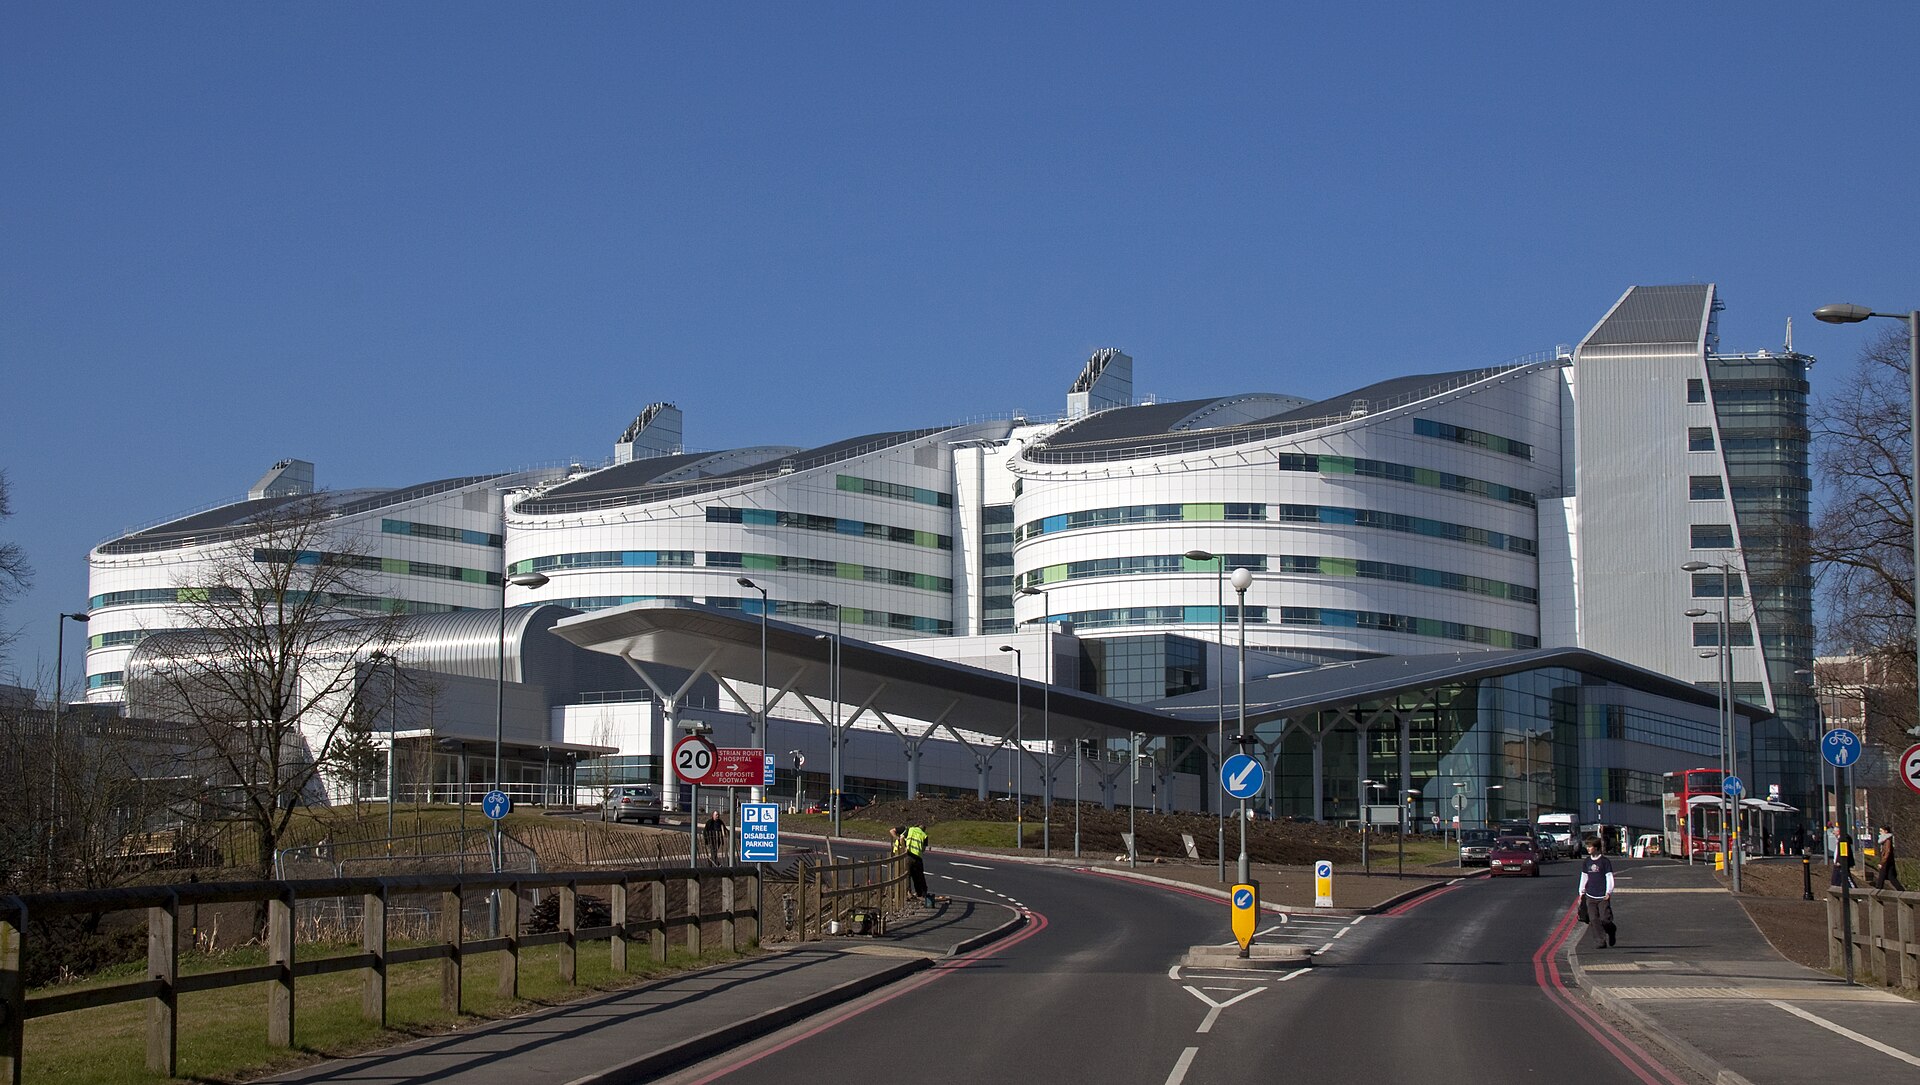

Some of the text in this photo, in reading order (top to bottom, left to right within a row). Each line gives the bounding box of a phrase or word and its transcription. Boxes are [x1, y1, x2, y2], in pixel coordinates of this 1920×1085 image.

[679, 749, 710, 769] 20
[1910, 759, 1920, 779] 2
[746, 808, 756, 821] P
[751, 824, 768, 832] FREE
[743, 832, 776, 840] DISABLED
[745, 840, 774, 848] PARKING
